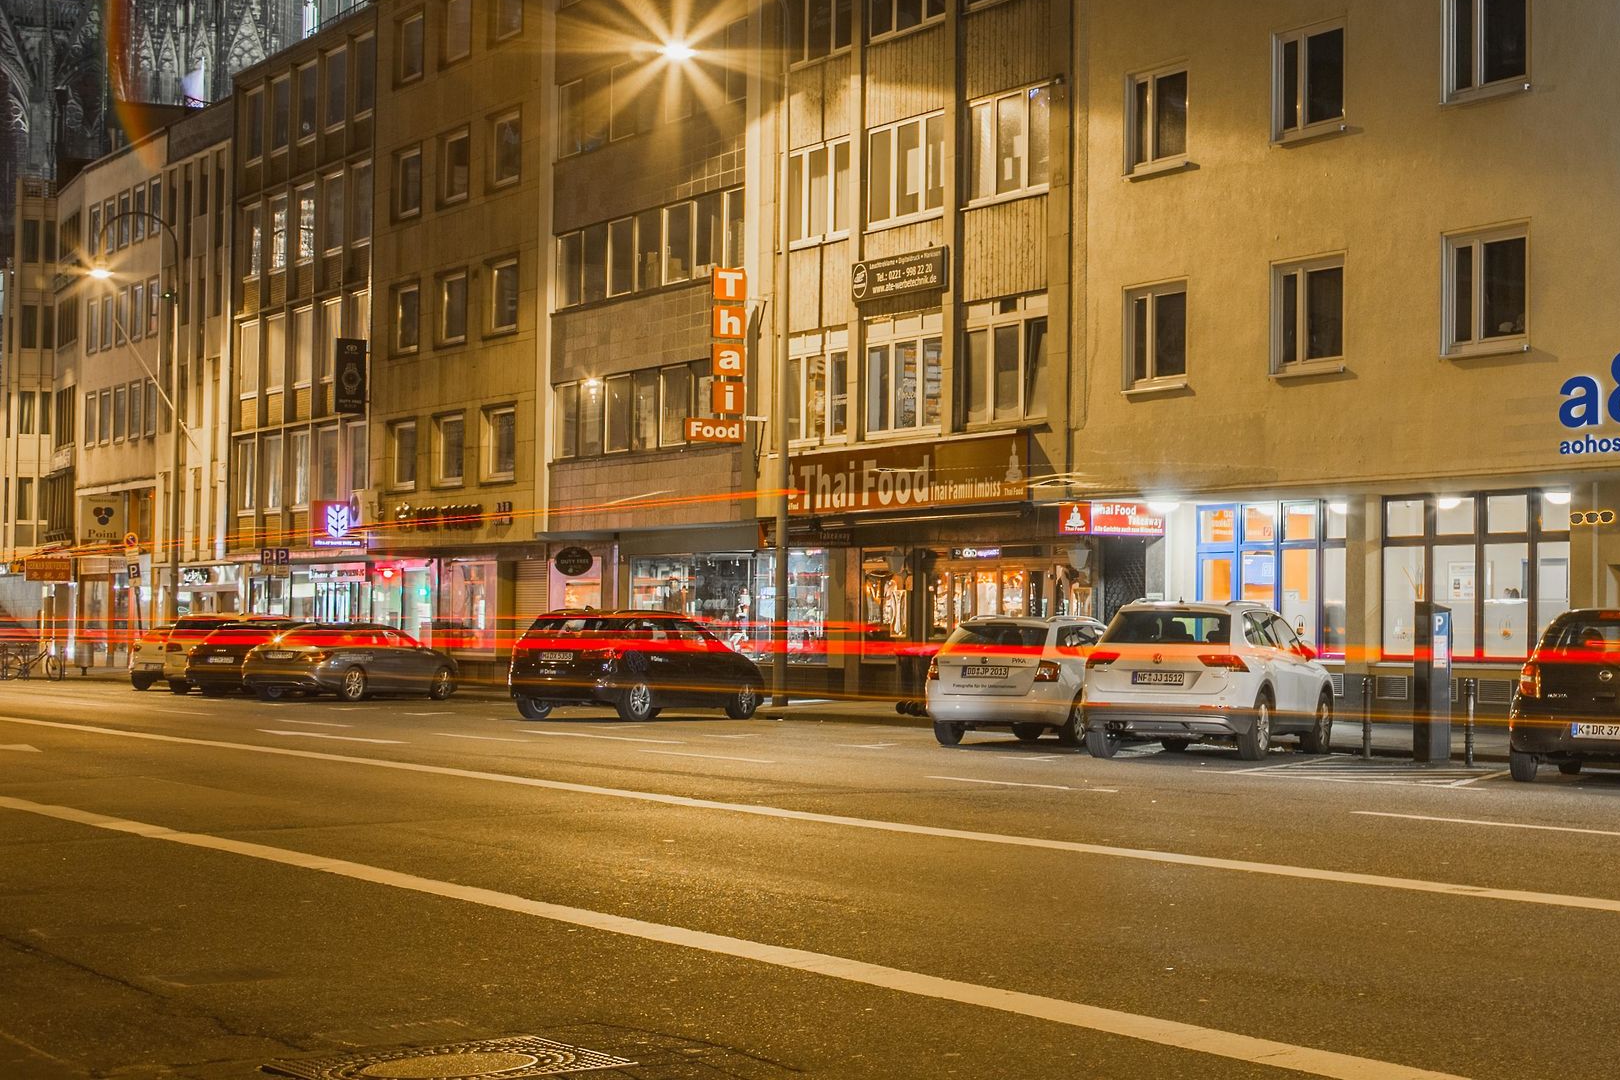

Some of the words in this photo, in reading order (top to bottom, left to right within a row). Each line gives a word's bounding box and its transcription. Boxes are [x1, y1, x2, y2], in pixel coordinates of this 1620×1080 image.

[889, 269, 901, 280] 0221
[917, 264, 924, 275] 22
[925, 263, 933, 273] 20
[872, 274, 937, 294] www.ate-werbetechnik.de
[718, 271, 743, 410] Thai
[690, 421, 740, 439] Food
[800, 460, 856, 510] Thai
[862, 454, 930, 506] Food
[930, 480, 948, 501] Thai
[949, 476, 974, 500] Famili
[974, 475, 1001, 498] Imbiss
[1004, 487, 1013, 496] Thai
[1013, 486, 1024, 496] Food
[1115, 505, 1137, 515] Food
[88, 529, 117, 538] Point
[264, 550, 271, 563] P
[278, 550, 286, 563] P
[129, 565, 138, 578] P
[1435, 615, 1443, 631] P
[980, 667, 989, 676] JP
[990, 667, 1007, 676] 2013
[1138, 673, 1147, 682] NF
[1153, 674, 1163, 682] JJ
[1164, 674, 1183, 682] 1512
[1578, 725, 1585, 735] K
[1592, 725, 1605, 736] DR
